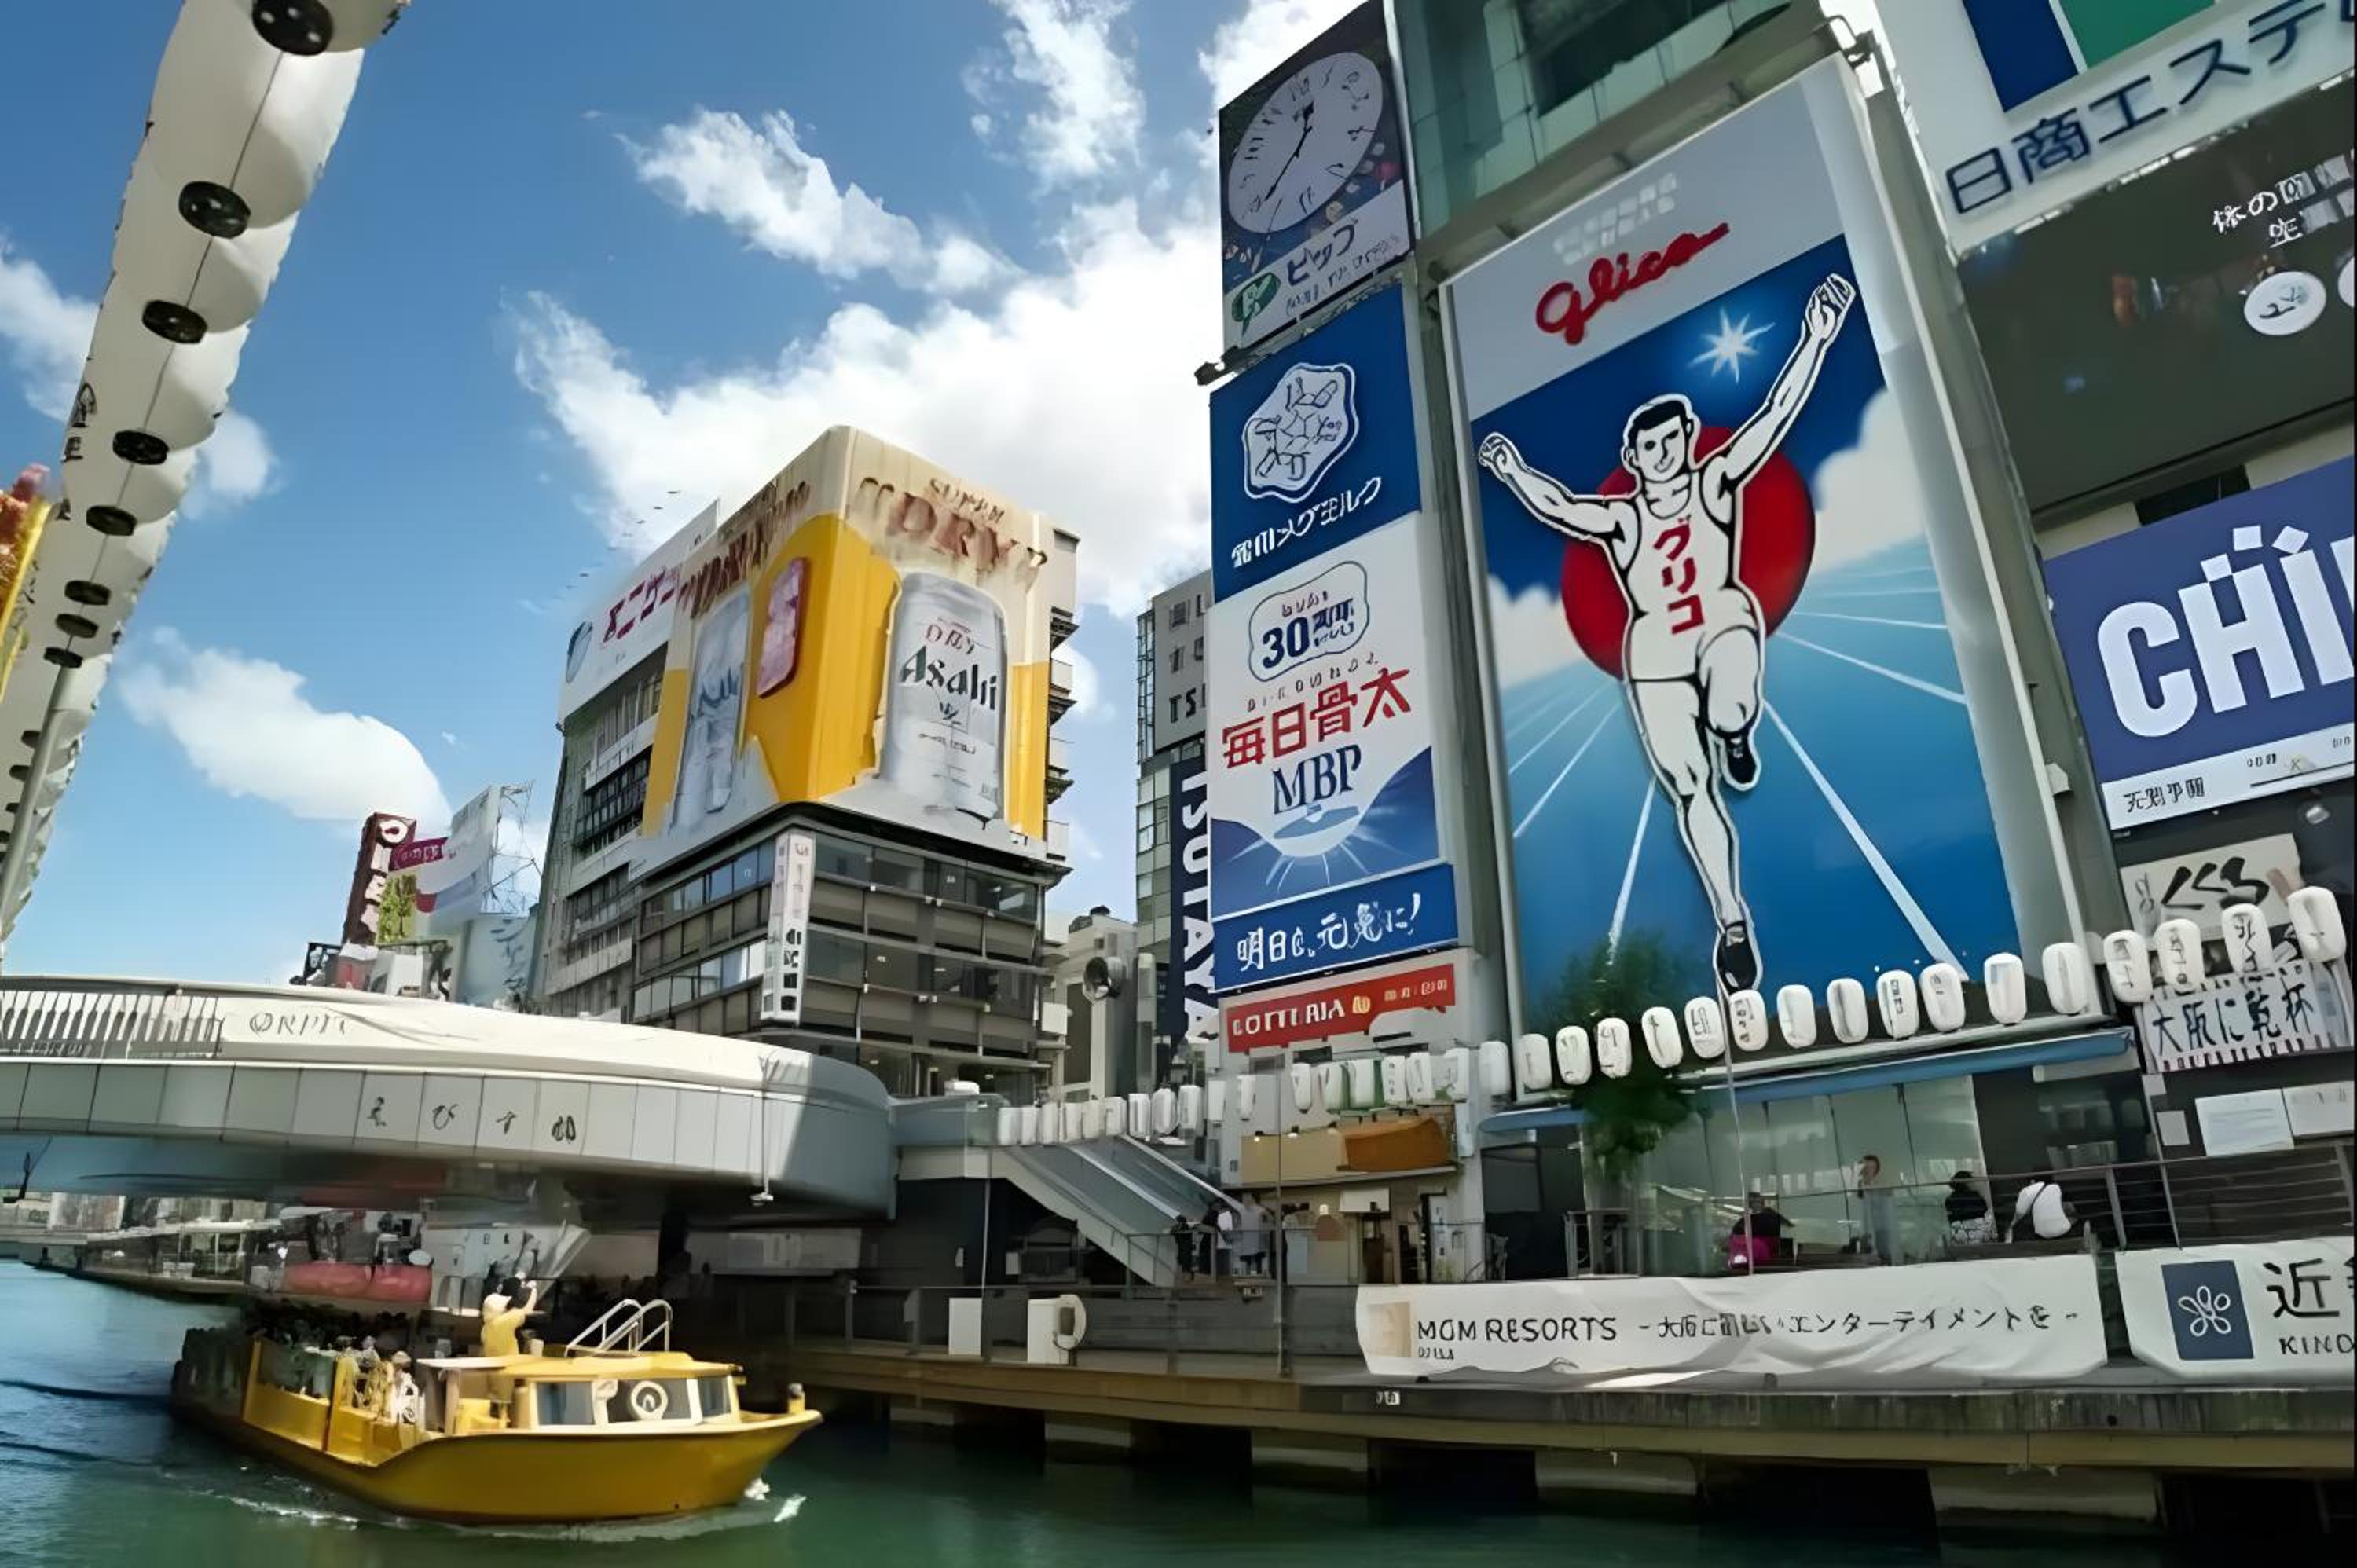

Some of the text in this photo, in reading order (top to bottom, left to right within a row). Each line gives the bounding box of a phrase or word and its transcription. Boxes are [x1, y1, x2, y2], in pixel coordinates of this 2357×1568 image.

[1946, 0, 2355, 214] 日商エステ
[1653, 515, 1704, 635] グリコ
[900, 645, 997, 710] Asahi
[2097, 534, 2355, 738] CHI
[1222, 667, 1411, 768] 毎日骨太
[1271, 744, 1362, 814] MBP
[1486, 1317, 1617, 1342] RESORTS
[2263, 1258, 2355, 1318] 近
